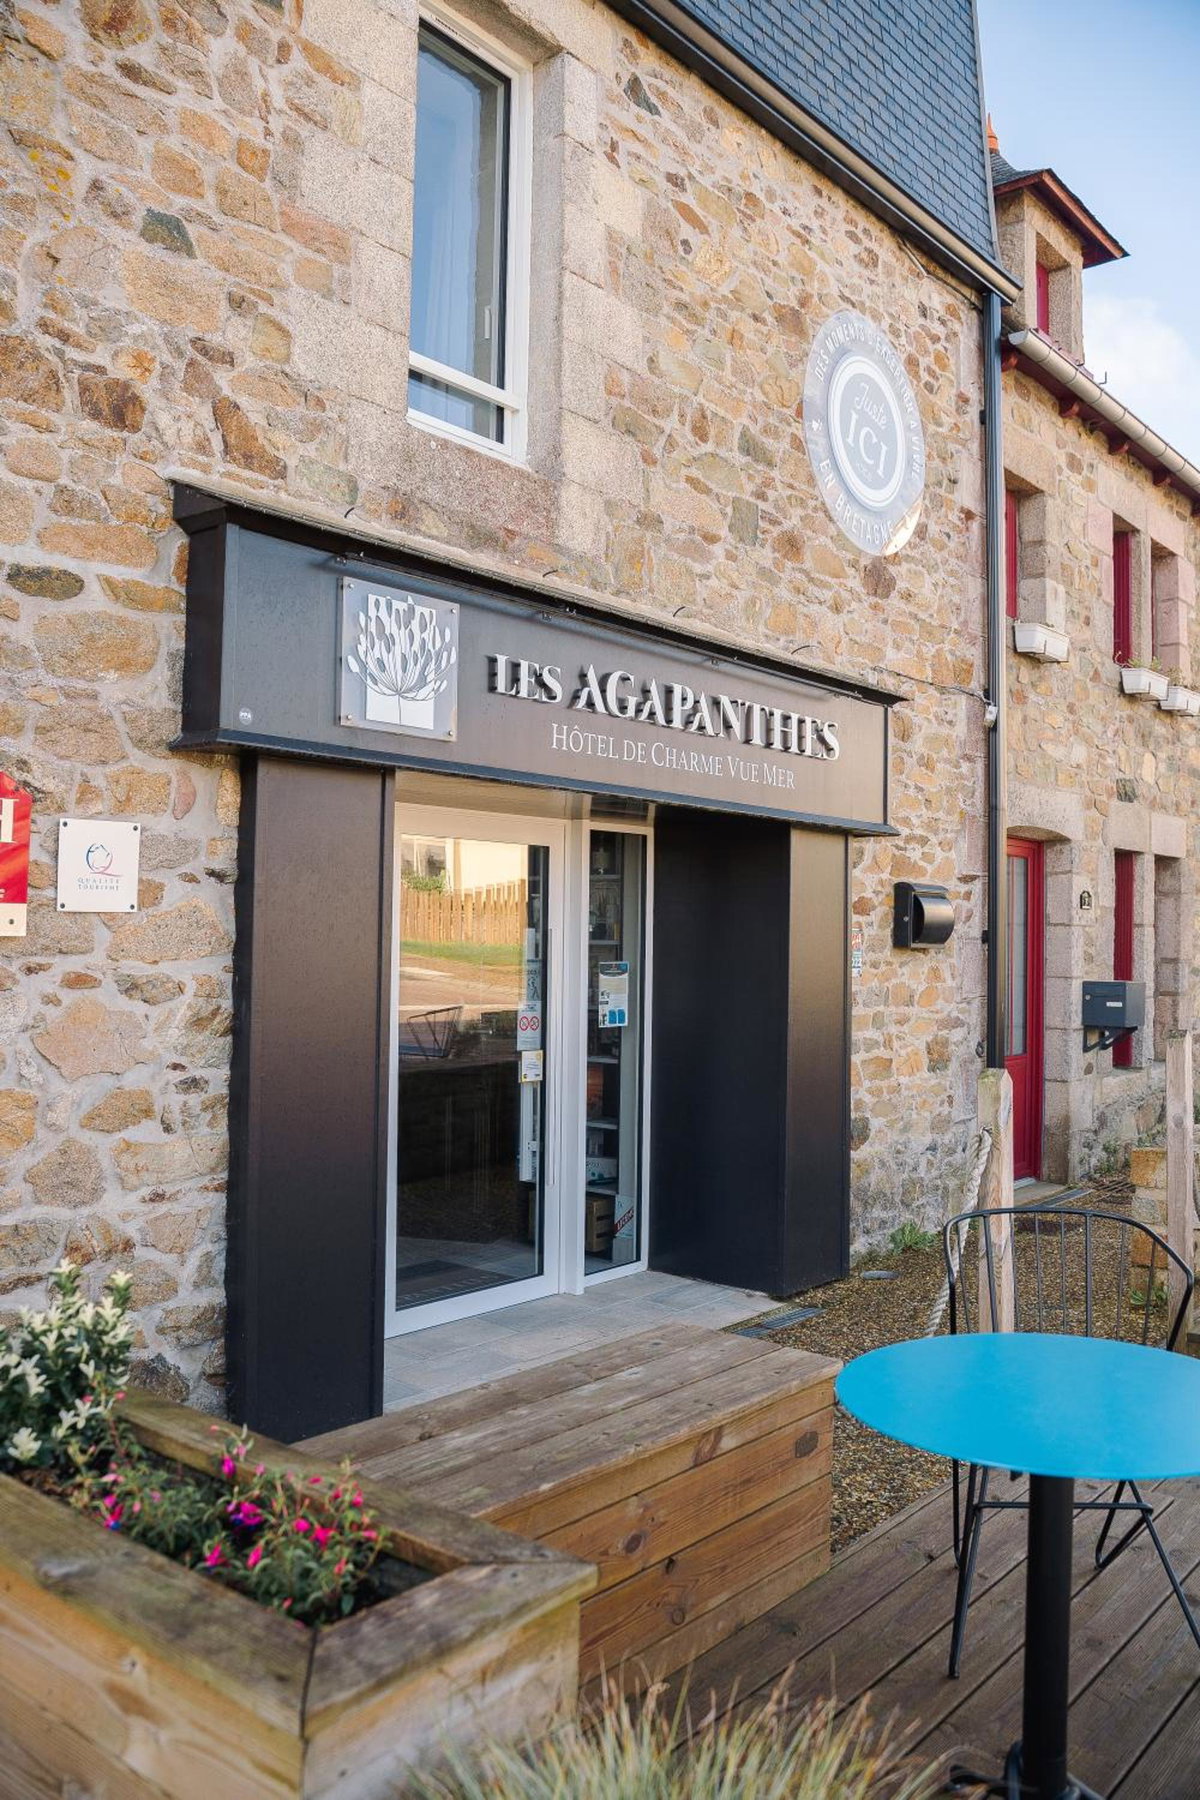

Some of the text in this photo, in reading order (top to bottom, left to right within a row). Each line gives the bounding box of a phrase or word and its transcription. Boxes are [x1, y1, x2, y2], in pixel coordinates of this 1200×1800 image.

[855, 382, 887, 430] Juste
[819, 458, 836, 489] EN
[847, 409, 888, 479] ICI
[494, 653, 840, 761] LES AGAPANTHES
[551, 723, 796, 790] HÔTEL DE CHARME VUE MER
